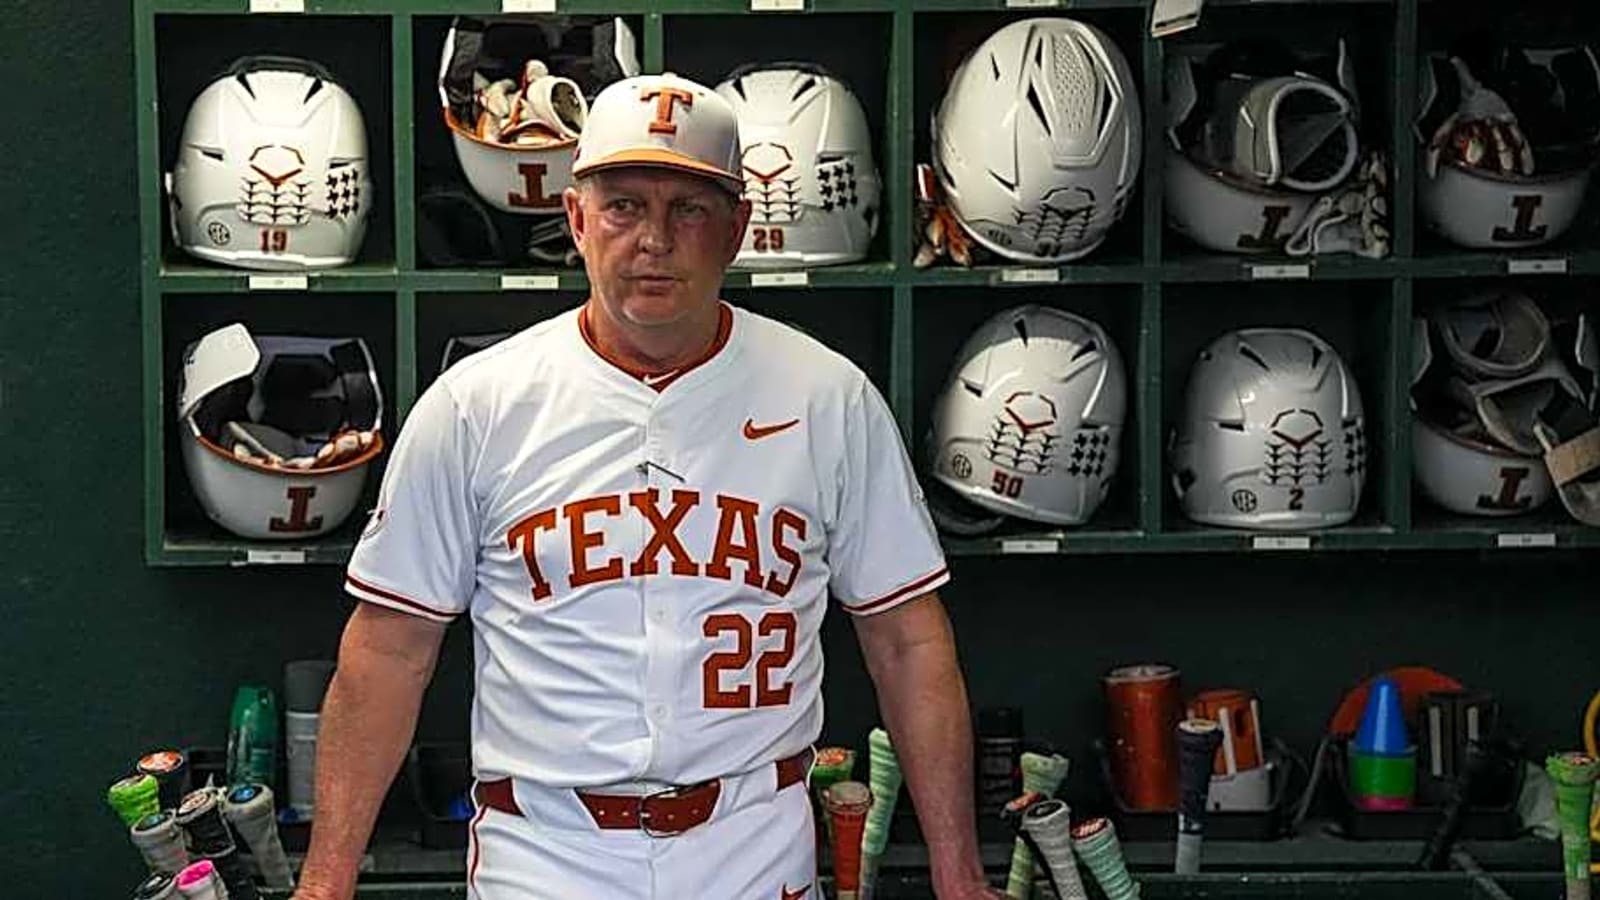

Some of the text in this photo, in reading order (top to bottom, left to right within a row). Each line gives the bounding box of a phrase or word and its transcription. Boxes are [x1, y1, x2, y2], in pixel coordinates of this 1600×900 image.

[640, 86, 693, 134] T
[507, 162, 563, 208] T
[259, 228, 288, 253] 19
[752, 226, 784, 253] 29
[1491, 194, 1548, 242] T
[990, 470, 1024, 499] 50
[1288, 487, 1304, 511] 2
[1476, 466, 1531, 511] T
[269, 485, 323, 533] T
[506, 486, 808, 602] TEXAS
[701, 611, 799, 710] 22
